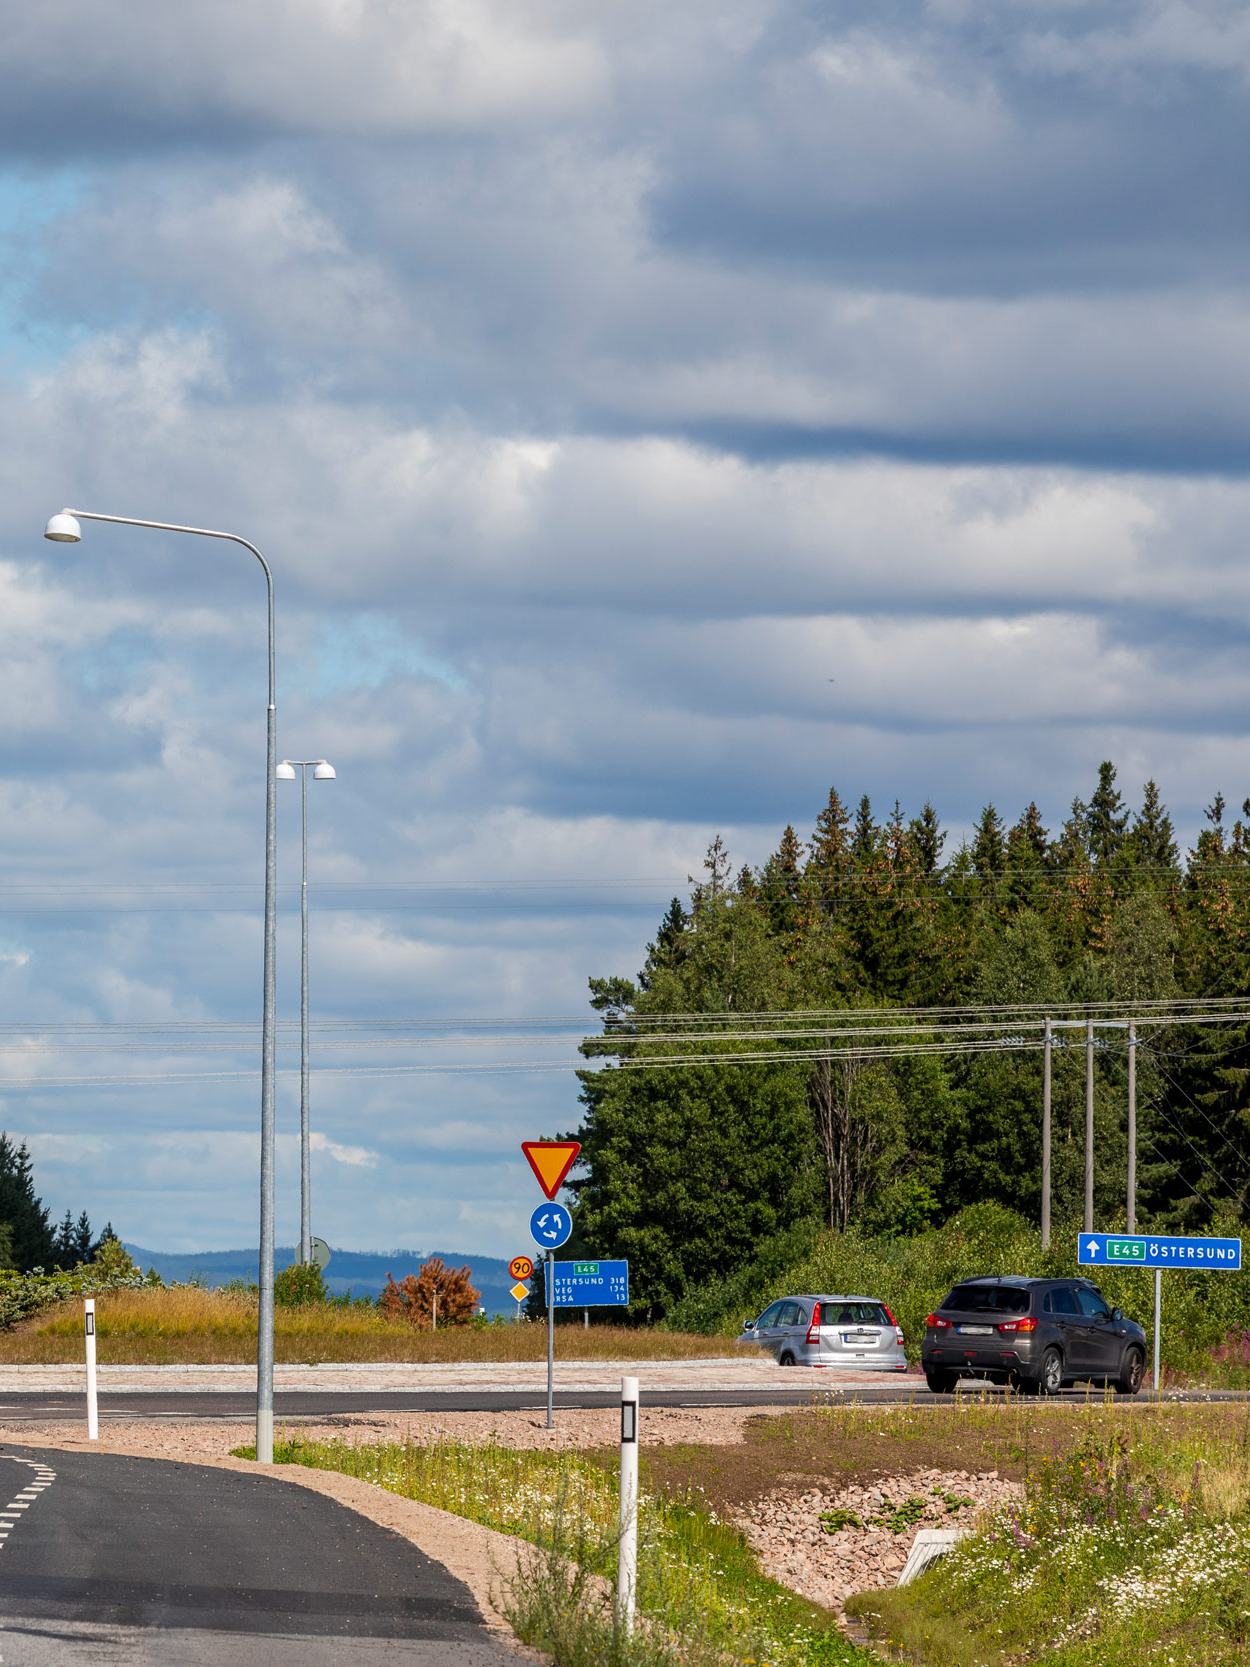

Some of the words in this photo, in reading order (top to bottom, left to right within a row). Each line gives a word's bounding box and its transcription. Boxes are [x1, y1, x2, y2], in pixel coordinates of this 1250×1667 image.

[1114, 1245, 1140, 1256] E45
[1150, 1243, 1235, 1260] ÖSTERSUND
[514, 1262, 530, 1274] 90
[577, 1265, 595, 1273] E45
[555, 1277, 604, 1286] STERSUND
[610, 1276, 625, 1284] 318
[555, 1286, 573, 1294] VEG
[553, 1295, 574, 1303] RSA
[616, 1293, 626, 1301] 13
